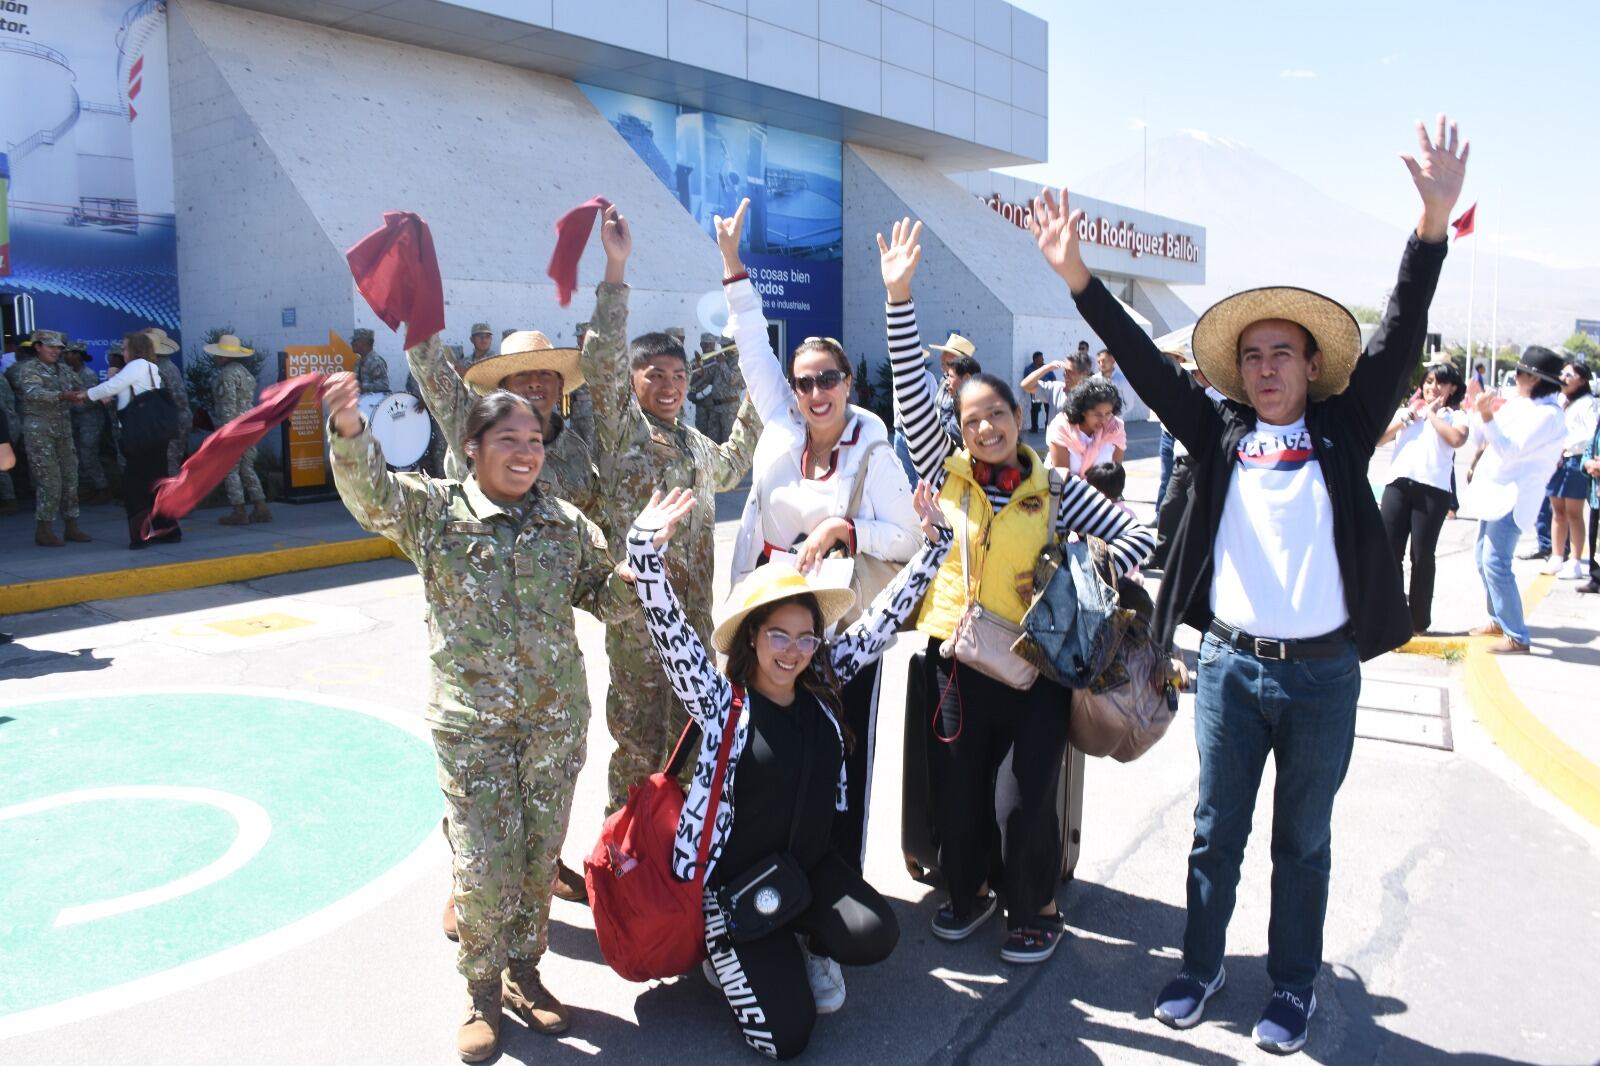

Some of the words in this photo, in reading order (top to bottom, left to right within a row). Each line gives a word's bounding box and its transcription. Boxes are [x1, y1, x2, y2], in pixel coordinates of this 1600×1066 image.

[0, 0, 28, 15] ión
[0, 18, 31, 35] tor.
[760, 268, 789, 282] cosas
[791, 268, 811, 284] bien
[755, 281, 785, 296] todos
[289, 352, 344, 366] MÓDULO
[289, 366, 306, 377] DE
